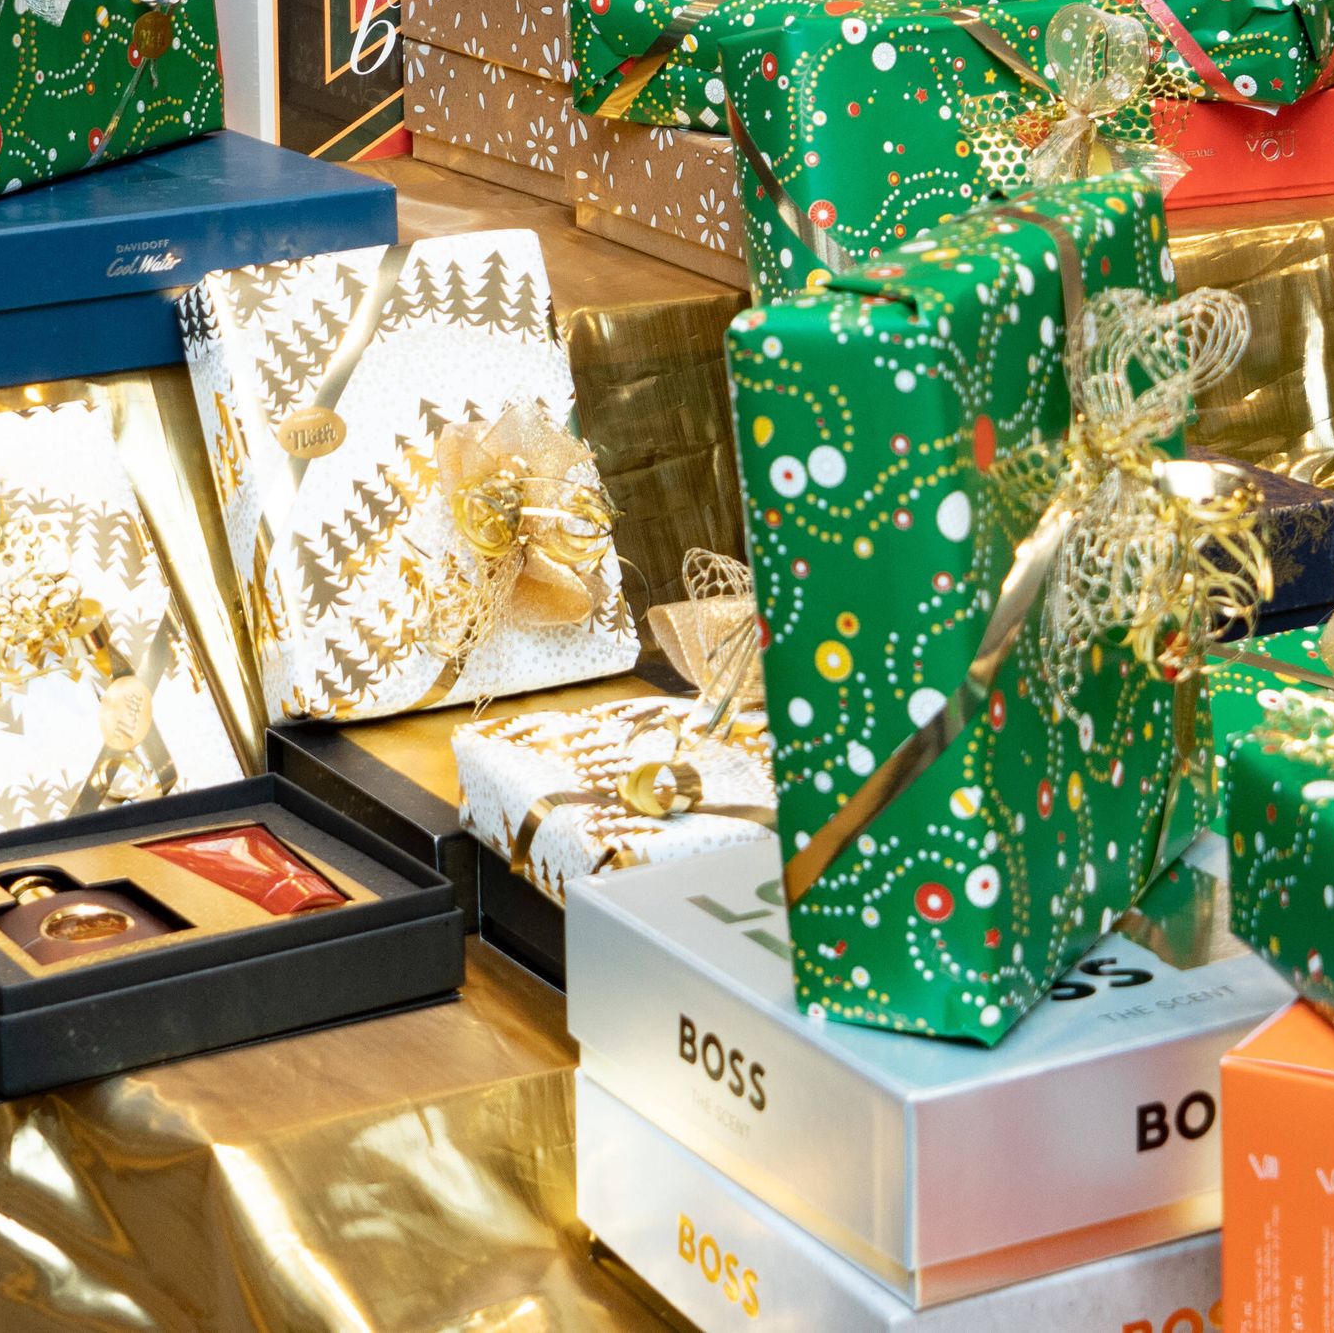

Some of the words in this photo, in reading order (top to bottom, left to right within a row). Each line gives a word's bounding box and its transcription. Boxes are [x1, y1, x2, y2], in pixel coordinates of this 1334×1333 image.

[1245, 137, 1296, 162] YOU
[107, 255, 141, 278] Cool
[137, 252, 182, 275] Water
[115, 239, 170, 254] DAVIDOFF
[1097, 1004, 1155, 1023] THE
[1156, 984, 1236, 1010] SCENT
[679, 1013, 766, 1112] BOSS
[1136, 1089, 1217, 1153] BO
[678, 1211, 760, 1319] BOSS
